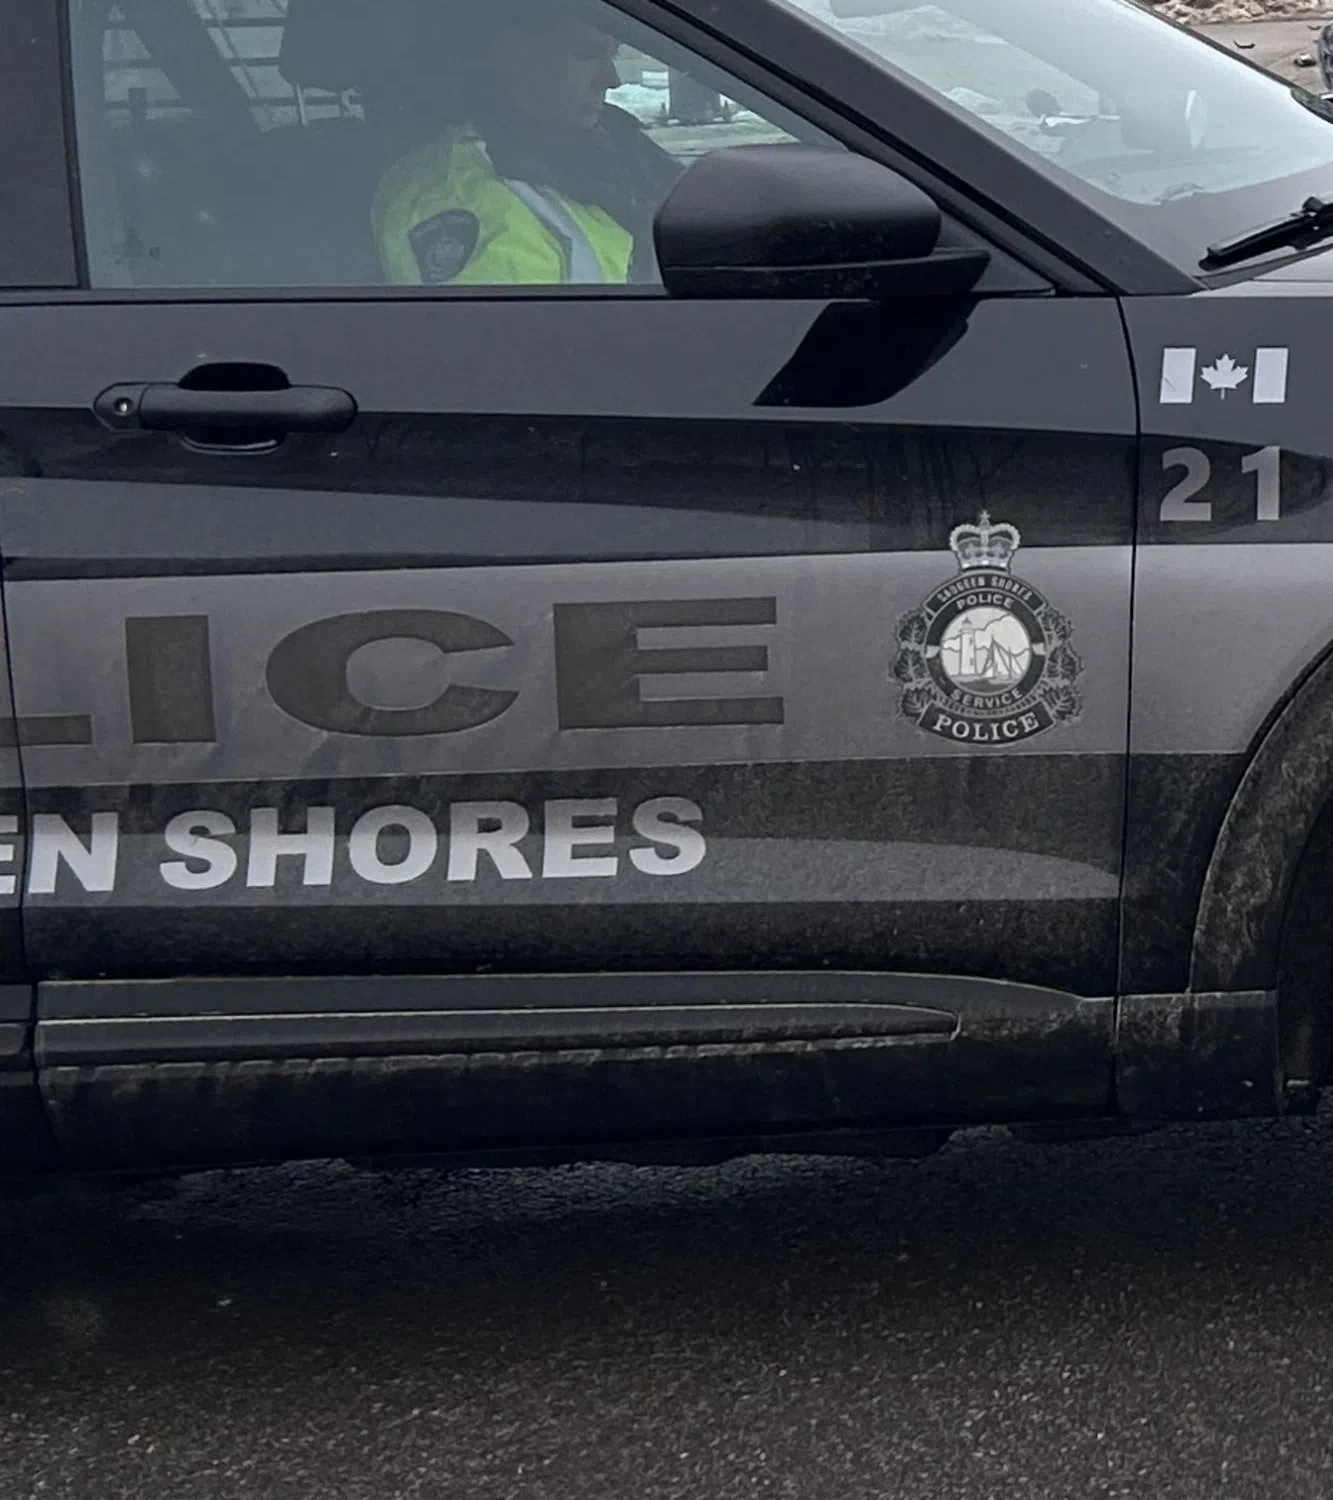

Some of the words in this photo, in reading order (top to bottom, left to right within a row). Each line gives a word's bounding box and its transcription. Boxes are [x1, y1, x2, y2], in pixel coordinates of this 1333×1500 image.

[1159, 445, 1281, 522] 21
[956, 593, 1013, 610] POLICE
[991, 576, 1033, 601] SHORES
[951, 687, 1022, 709] SERVICE
[933, 711, 1040, 740] POLICE
[160, 797, 706, 890] SHORES
